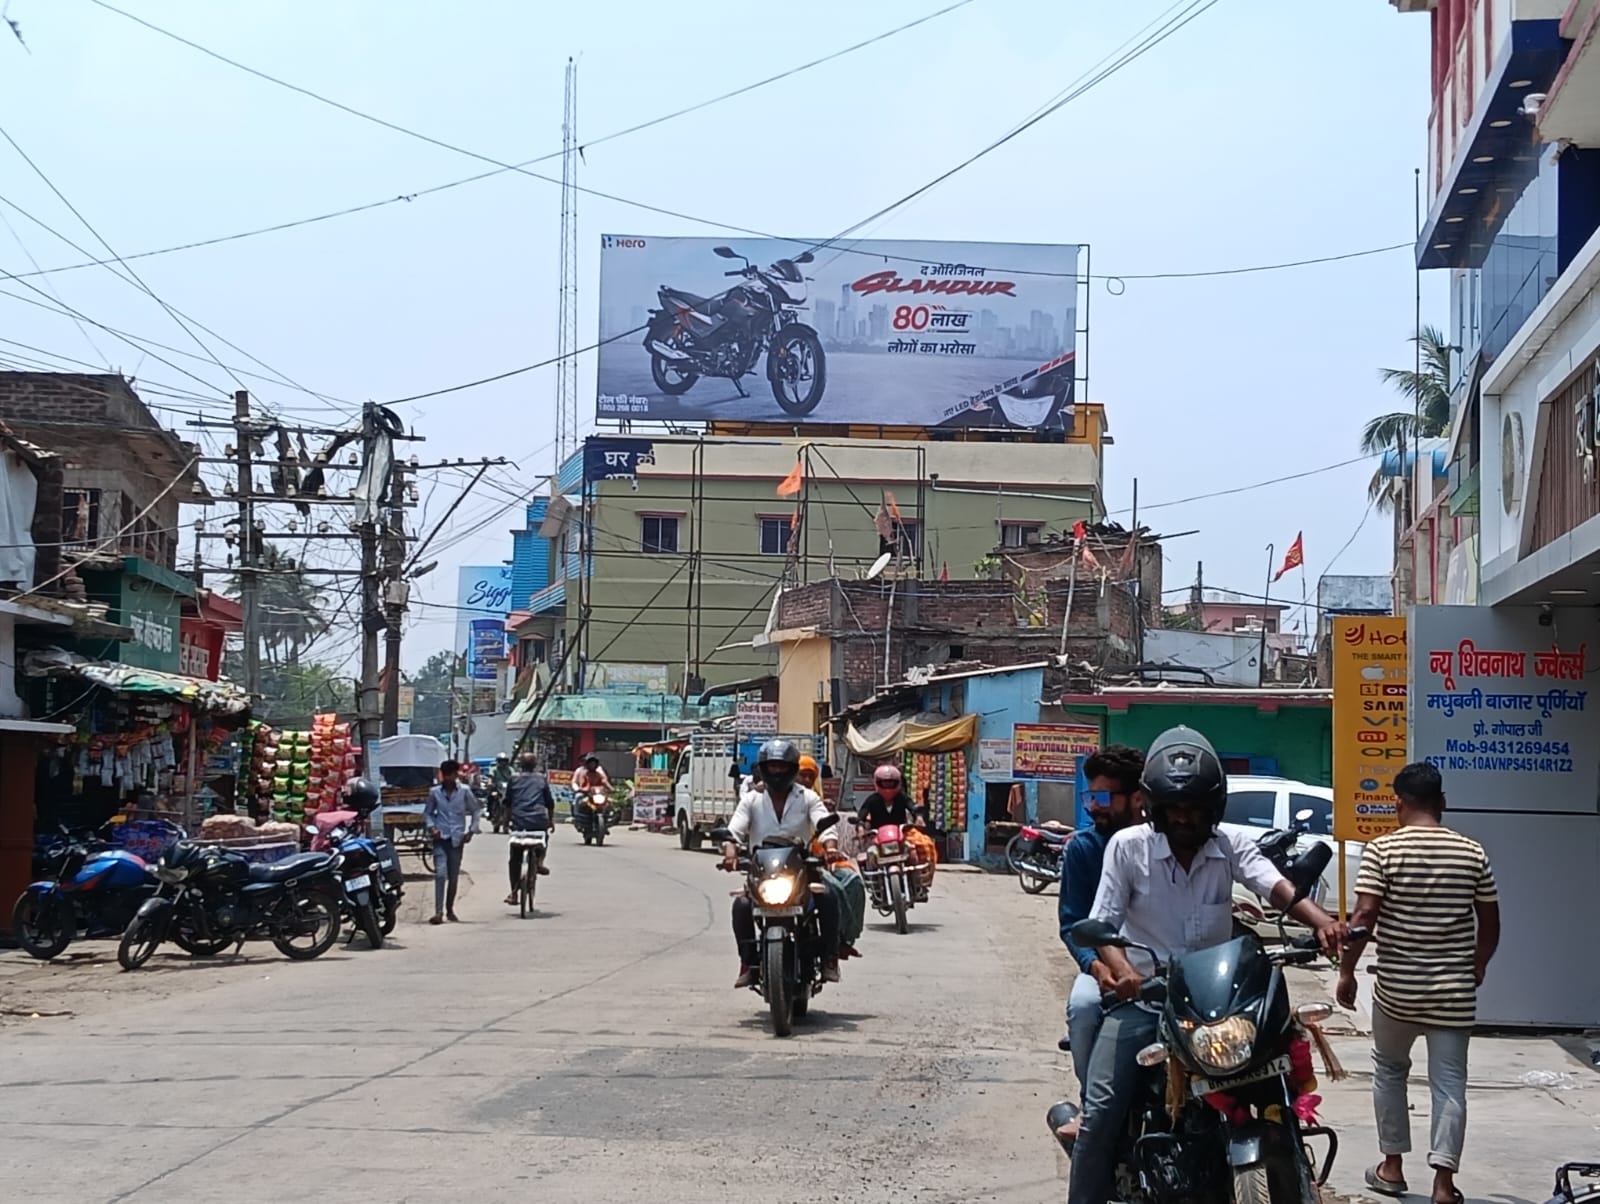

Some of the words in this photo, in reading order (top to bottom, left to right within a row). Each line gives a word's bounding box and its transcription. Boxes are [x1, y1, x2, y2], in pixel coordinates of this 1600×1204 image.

[616, 239, 646, 249] Hero
[920, 265, 929, 276] द
[930, 263, 986, 277] ओरिजिनल
[851, 270, 1017, 297] GLAMOUR
[892, 305, 930, 331] 80
[887, 338, 919, 353] लोगों
[920, 342, 938, 353] का
[940, 340, 976, 355] भरोसा
[955, 401, 970, 413] LED
[603, 452, 630, 467] घर
[1352, 652, 1369, 661] THE
[1371, 652, 1402, 661] SMART
[1429, 651, 1456, 690] न्यू
[1458, 639, 1527, 678] शिवनाथ
[1427, 688, 1483, 718] मधुबनी
[1491, 719, 1525, 737] गोपाल
[1527, 720, 1543, 737] जी
[1446, 739, 1570, 755] Mob-9431269454
[1425, 756, 1446, 770] GST
